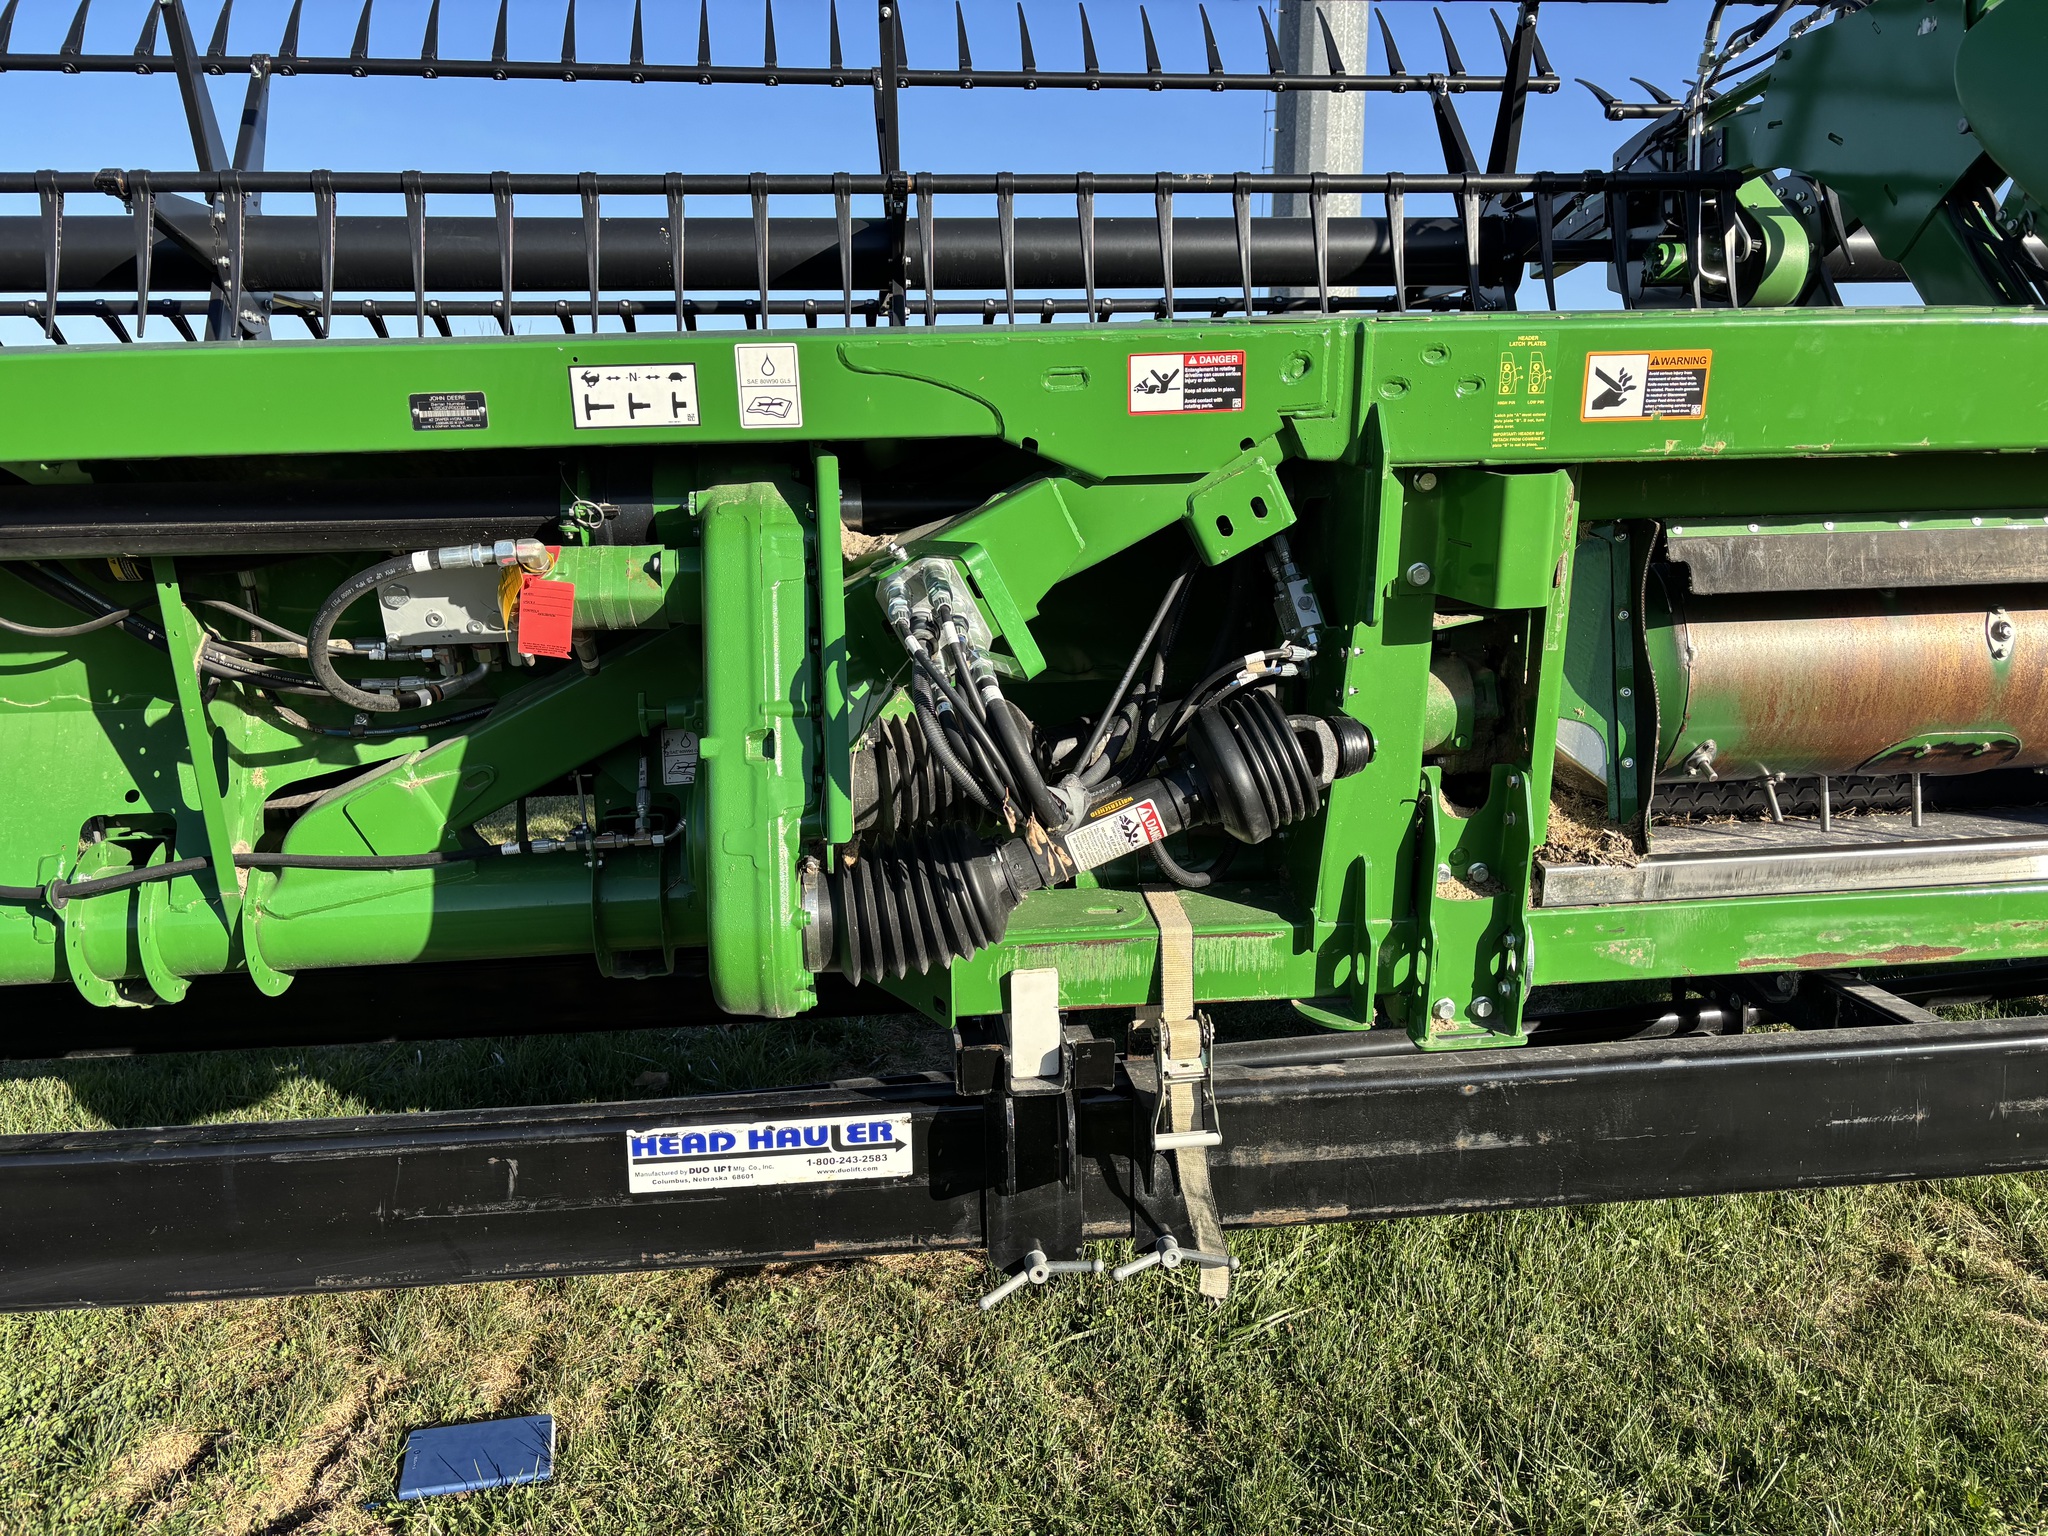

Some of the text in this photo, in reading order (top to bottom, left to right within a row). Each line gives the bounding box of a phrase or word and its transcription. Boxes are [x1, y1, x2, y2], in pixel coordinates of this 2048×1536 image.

[1200, 355, 1238, 364] DANGER
[1661, 357, 1707, 365] WARNING
[1090, 796, 1134, 818] WALTERSCHEID
[632, 1122, 893, 1157] HEAD HAULER
[807, 1154, 888, 1166] 1-800-243-2583
[635, 1170, 678, 1178] Manufactured
[689, 1167, 710, 1175] DUO
[817, 1166, 878, 1175] www.duolift.com
